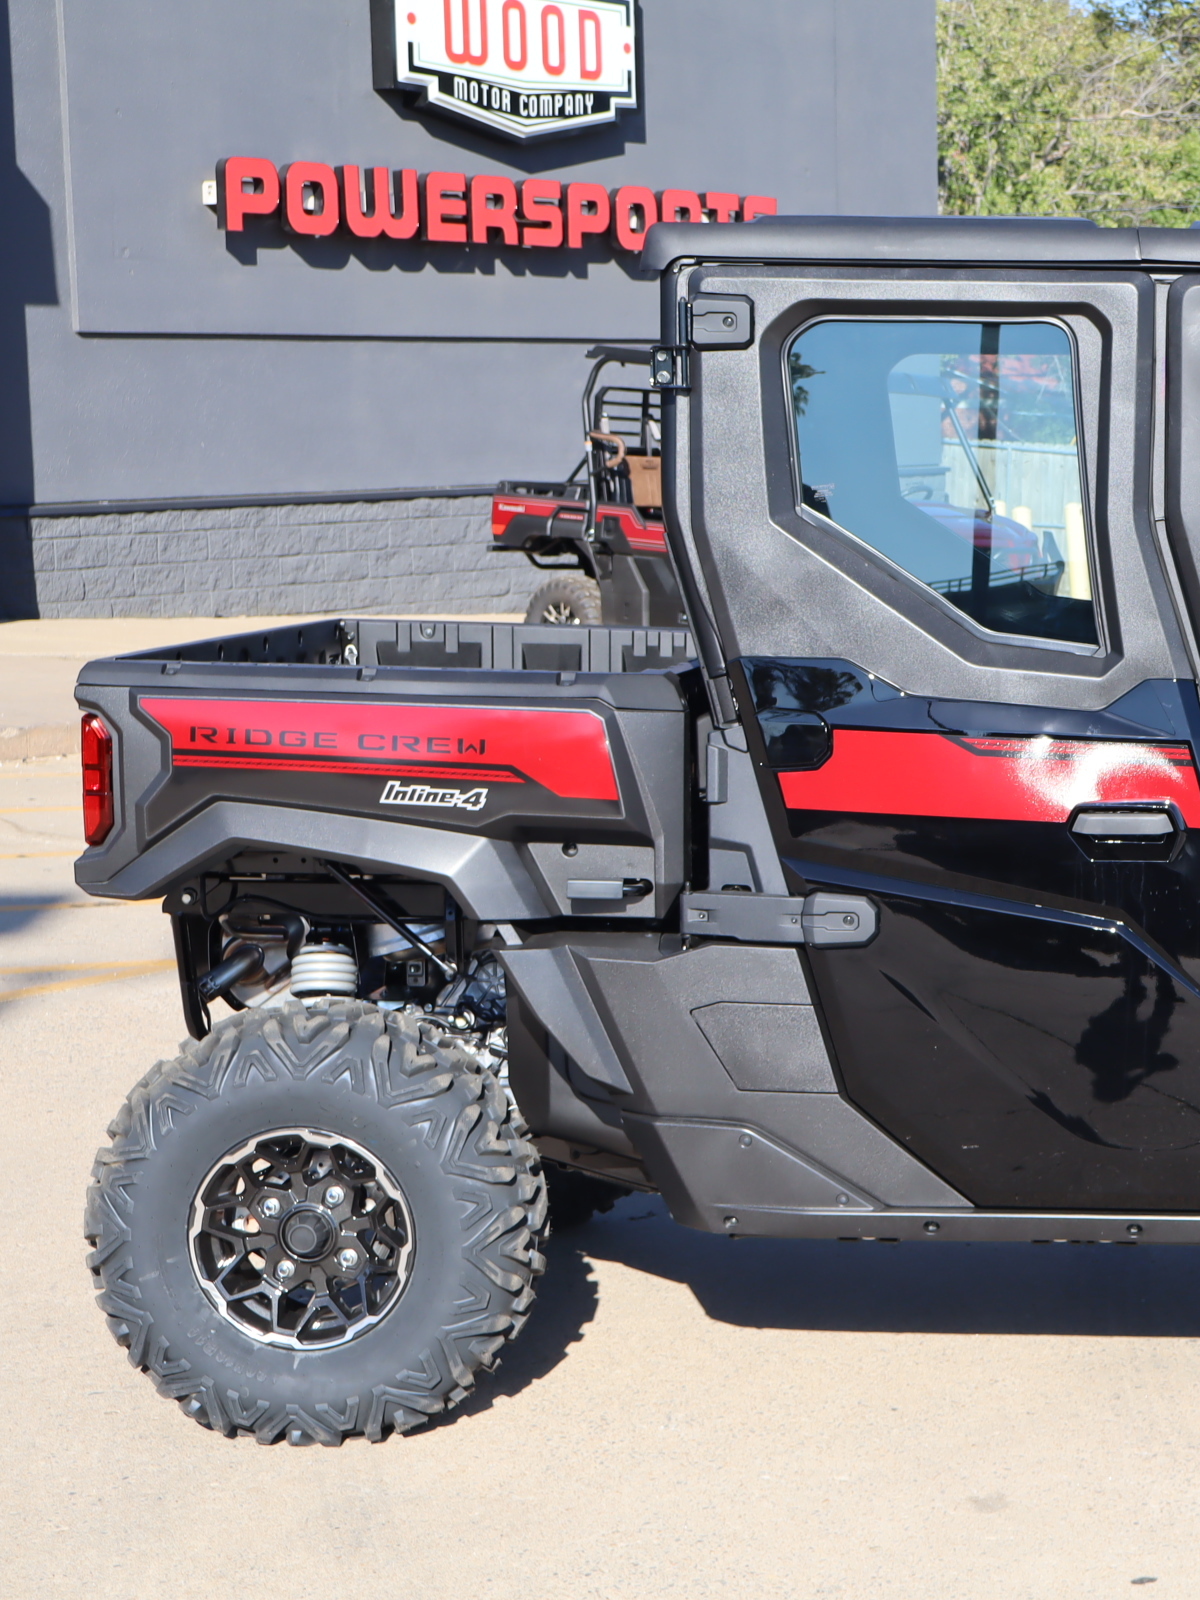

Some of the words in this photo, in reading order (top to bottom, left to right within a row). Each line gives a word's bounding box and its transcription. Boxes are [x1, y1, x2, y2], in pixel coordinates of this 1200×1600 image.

[443, 0, 602, 81] WOOD
[453, 76, 511, 112] MOTOR
[519, 93, 595, 118] COMPANY
[190, 726, 338, 749] RIDGE
[358, 733, 486, 755] CREW
[379, 780, 489, 811] Inline-4
